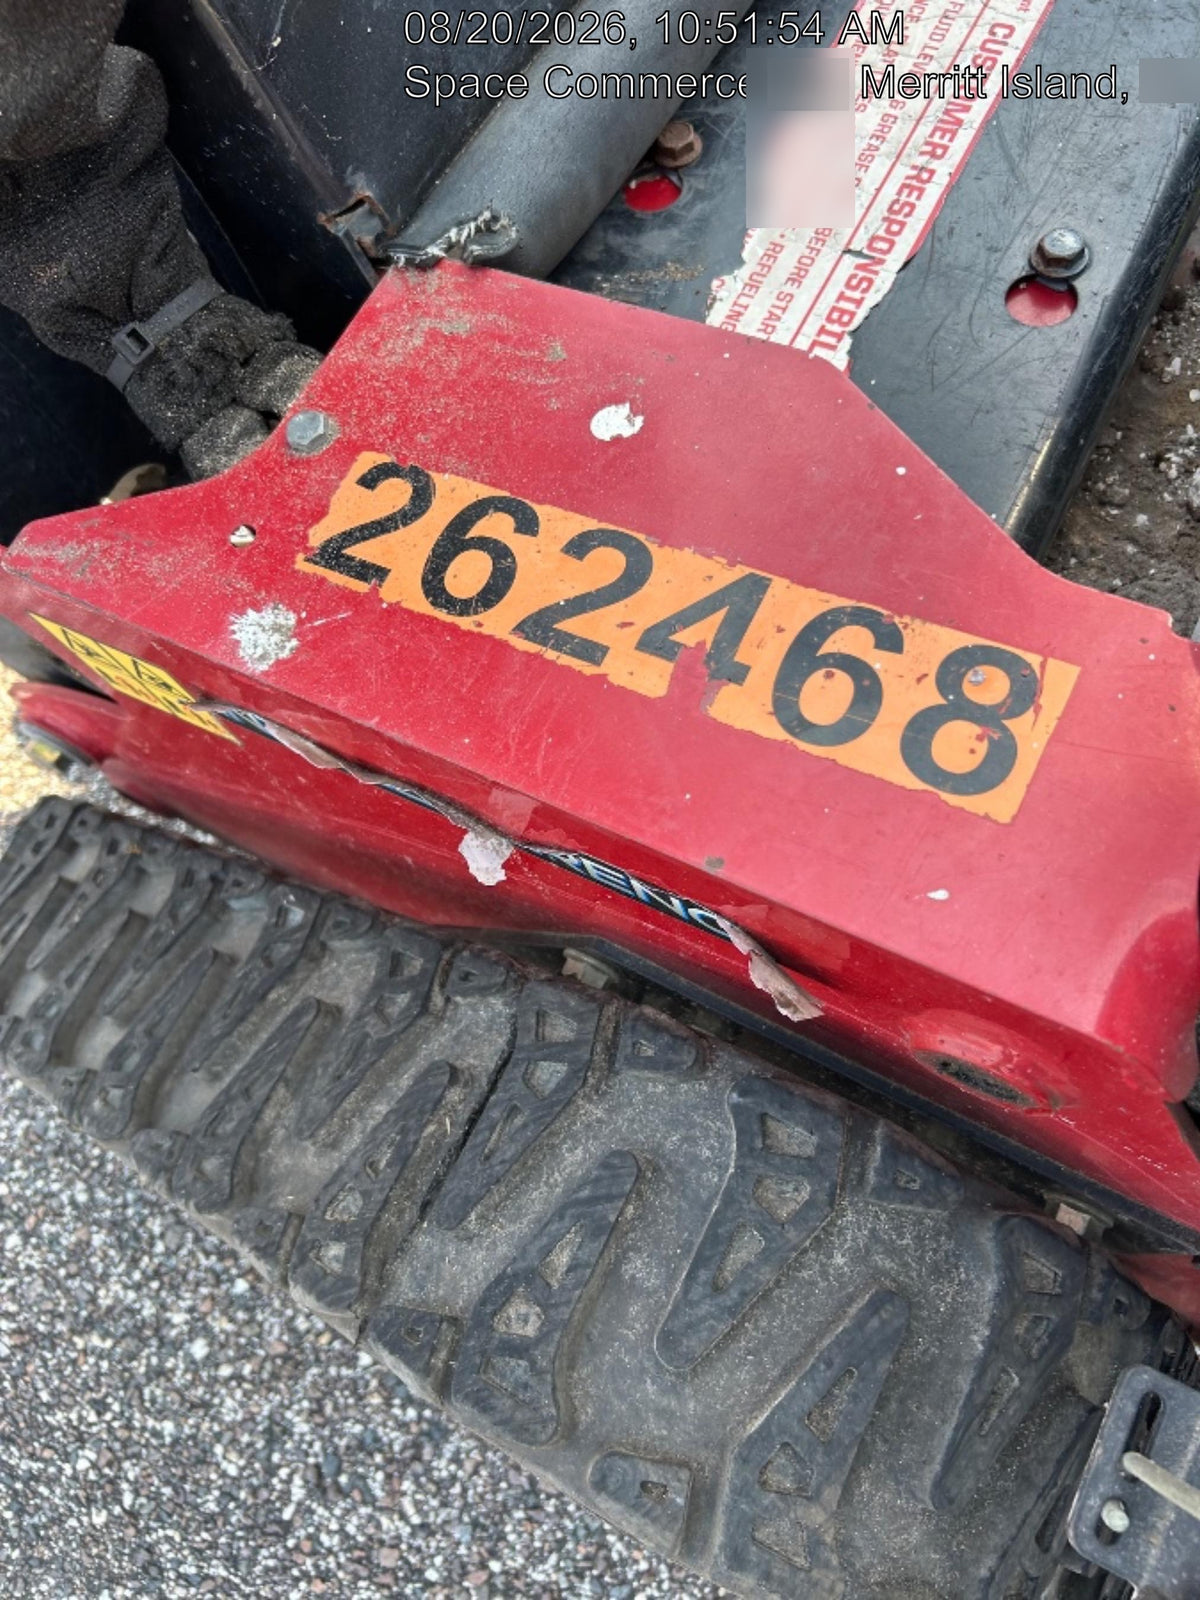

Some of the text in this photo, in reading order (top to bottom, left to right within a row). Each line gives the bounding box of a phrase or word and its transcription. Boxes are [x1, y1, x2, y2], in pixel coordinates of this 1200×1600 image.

[784, 228, 833, 289] BEFORE
[757, 290, 795, 338] STAR
[304, 460, 1040, 796] 262468
